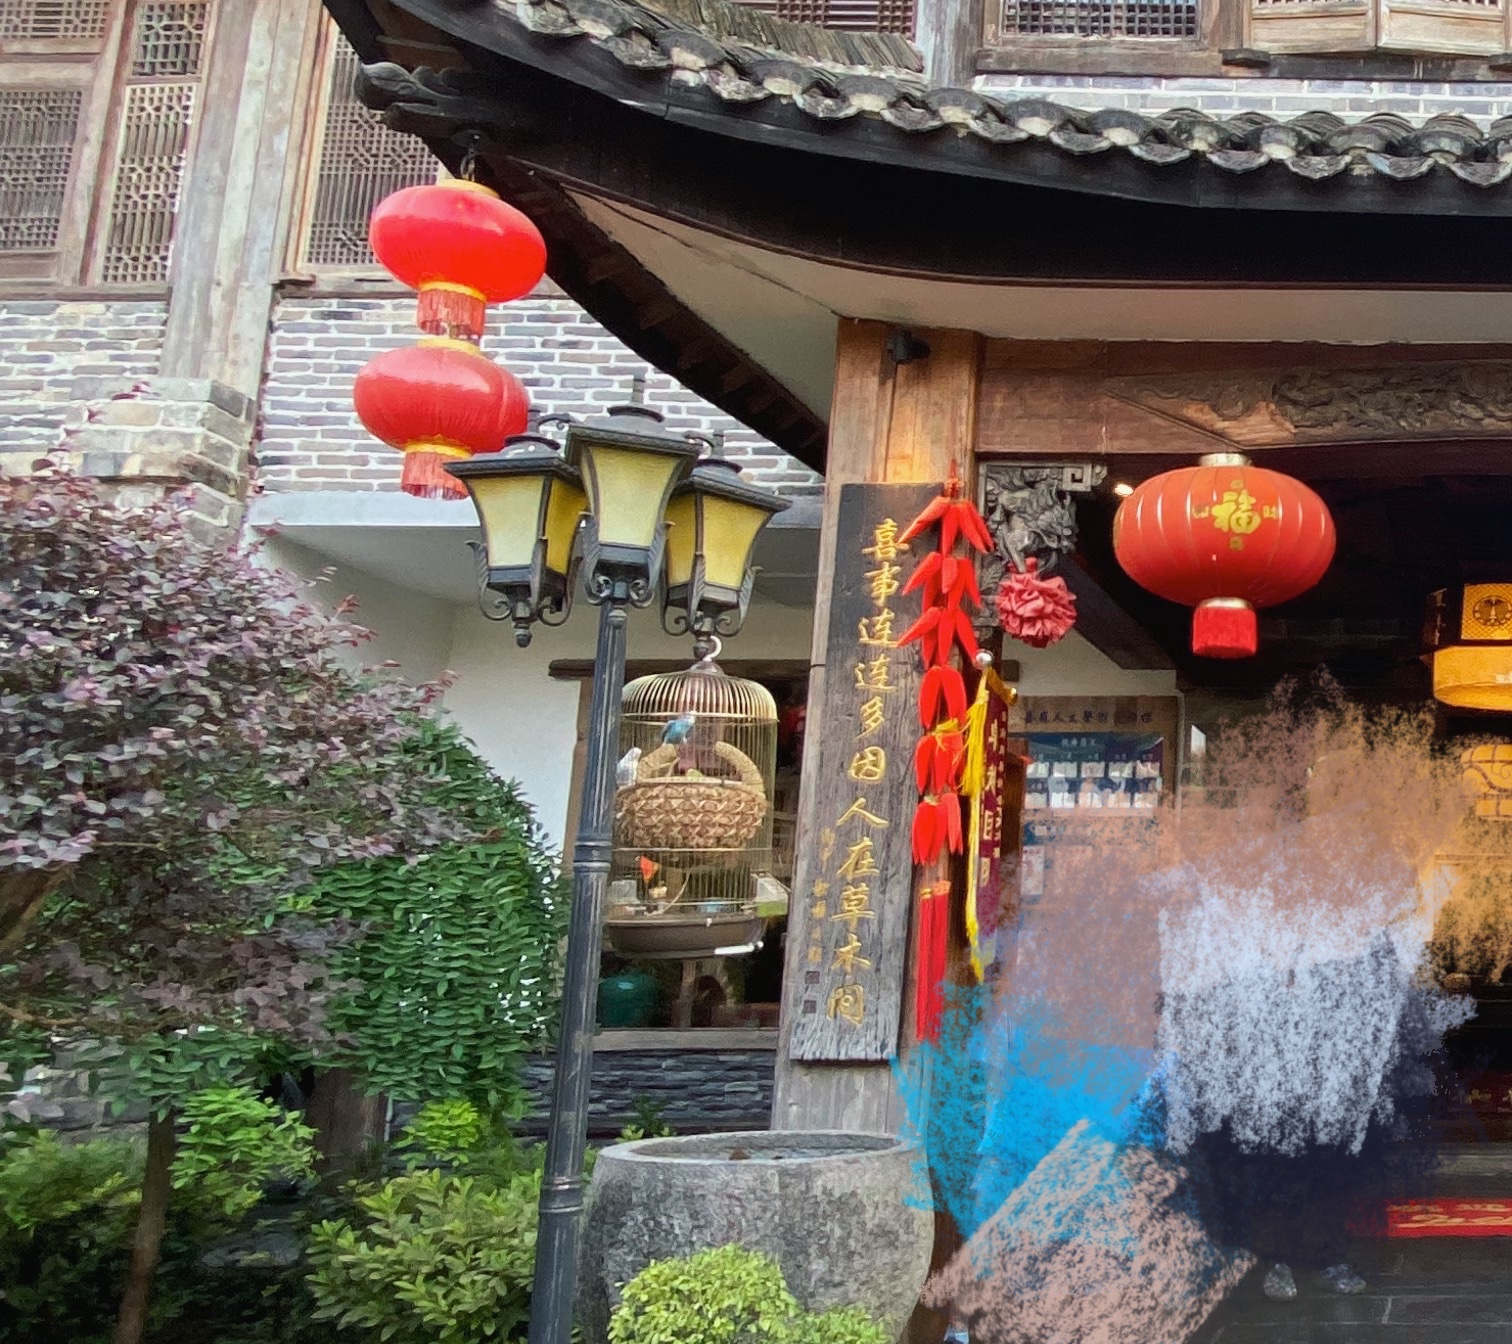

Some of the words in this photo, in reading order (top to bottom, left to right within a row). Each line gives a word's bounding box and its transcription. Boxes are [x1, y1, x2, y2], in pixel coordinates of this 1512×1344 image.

[1211, 489, 1262, 535] 福
[826, 518, 910, 1026] 喜事连连多因人在草木间
